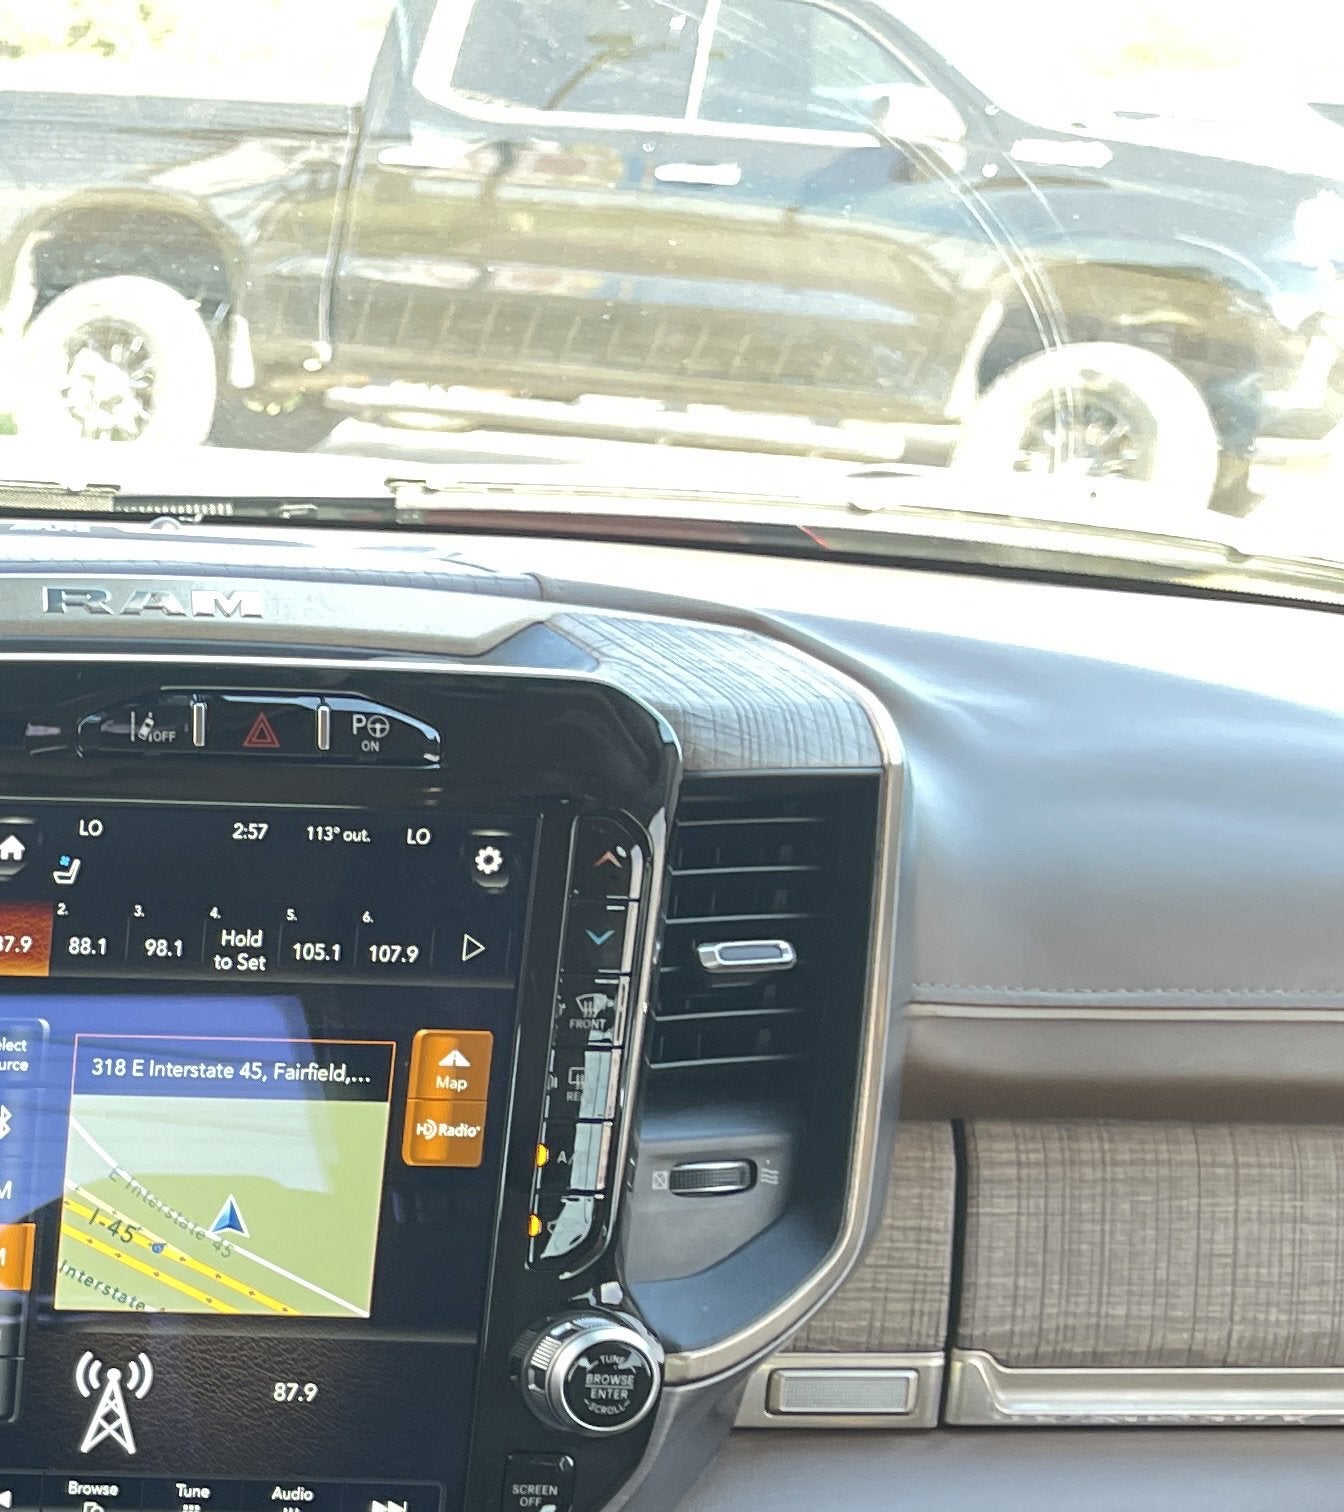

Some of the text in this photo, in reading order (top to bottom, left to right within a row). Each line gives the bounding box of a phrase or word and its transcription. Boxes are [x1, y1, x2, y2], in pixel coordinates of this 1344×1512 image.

[42, 586, 263, 618] RAM
[153, 730, 176, 743] OFF
[361, 740, 380, 753] ON
[79, 819, 103, 837] LO
[232, 822, 268, 840] 2:57
[307, 825, 371, 843] 113° out.
[406, 827, 431, 846] LO
[57, 903, 68, 915] 2.
[134, 905, 145, 918] 3.
[210, 906, 221, 919] 4.
[286, 908, 298, 921] 5.
[362, 911, 374, 923] 6.
[68, 937, 107, 955] 88.1
[220, 929, 263, 948] Hold
[144, 939, 183, 957] 98.1
[293, 943, 341, 961] 105.1
[369, 945, 418, 963] 107.9
[214, 954, 266, 971] to Set
[569, 1019, 607, 1030] FRONT
[91, 1059, 126, 1077] 318
[132, 1060, 143, 1076] E
[149, 1061, 234, 1080] Interstate
[239, 1063, 267, 1082] 45,
[436, 1076, 467, 1092] Map
[89, 1207, 136, 1244] I-45
[125, 1175, 207, 1242] Interstate
[212, 1239, 232, 1259] 45
[59, 1260, 146, 1312] Interstate
[586, 1373, 634, 1385] BROWSE
[273, 1383, 318, 1402] 87.9
[590, 1389, 628, 1400] ENTER
[588, 1401, 627, 1415] SCROLL
[68, 1481, 119, 1498] Browse
[176, 1483, 211, 1499] Tune
[271, 1486, 313, 1503] Audio
[512, 1484, 558, 1496] SCREEN
[519, 1497, 542, 1507] OFF
